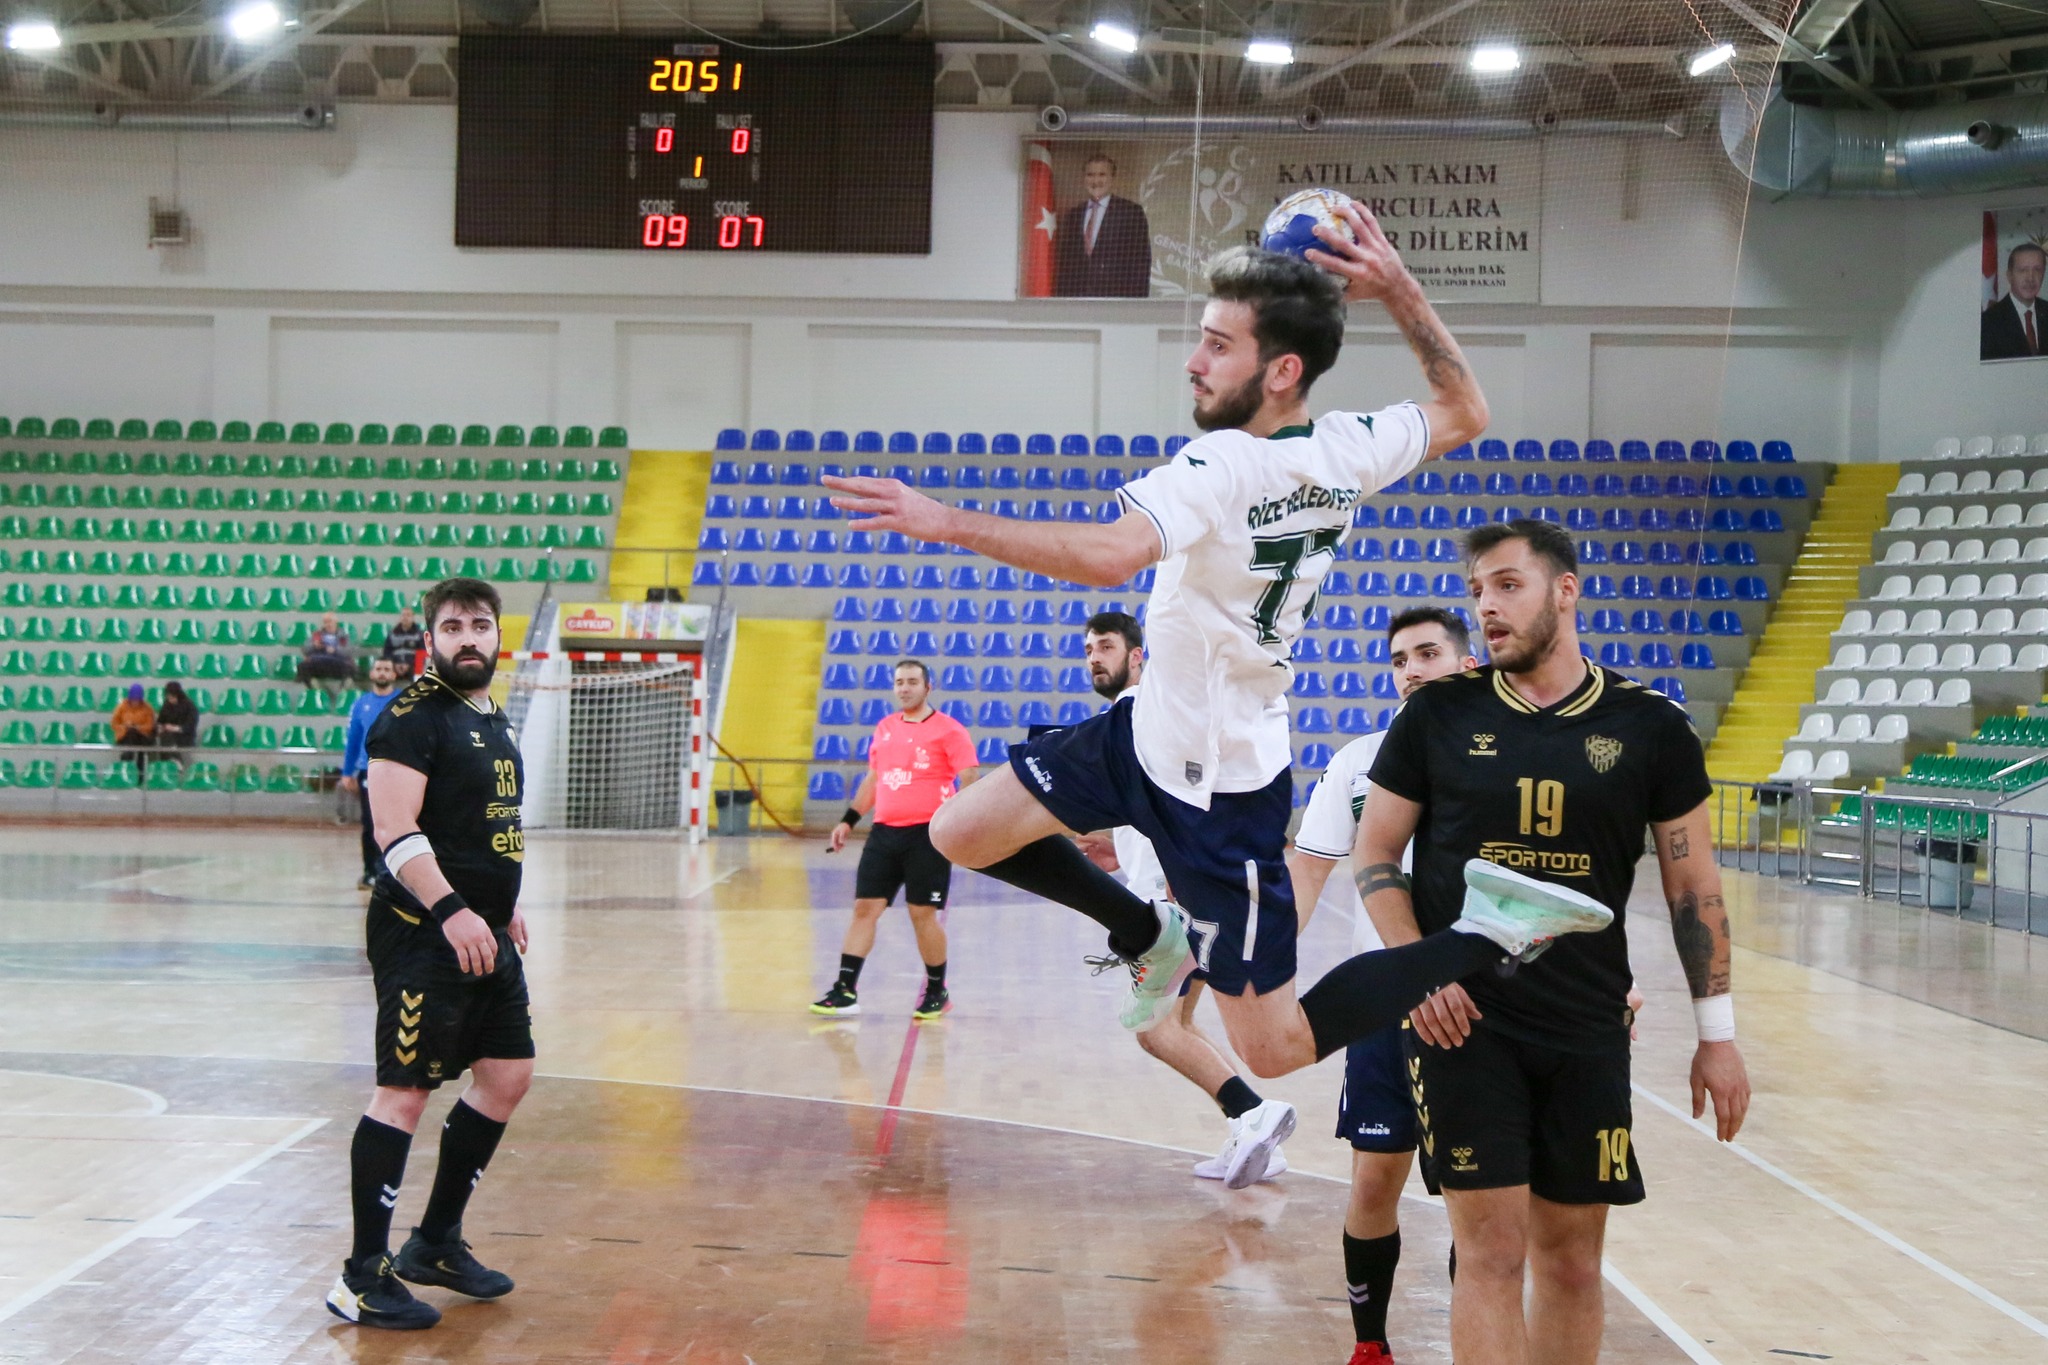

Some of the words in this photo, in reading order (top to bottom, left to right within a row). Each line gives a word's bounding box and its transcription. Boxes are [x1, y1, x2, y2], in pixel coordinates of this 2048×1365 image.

[655, 128, 674, 153] 0
[731, 129, 750, 154] 0
[694, 156, 703, 178] 1
[1277, 164, 1400, 184] KATILAN
[1408, 164, 1497, 184] TAKIM
[640, 200, 675, 215] SCORE
[714, 201, 750, 217] SCORE
[643, 215, 688, 247] 09
[719, 216, 764, 248] 07
[1409, 226, 1528, 251] DİLERİM
[1479, 264, 1505, 275] BAK
[1444, 279, 1468, 287] SPOR
[1248, 497, 1288, 530] RİZE
[494, 759, 517, 797] 33
[1516, 778, 1565, 837] 19
[492, 825, 524, 852] efo
[1595, 1127, 1631, 1182] 19
